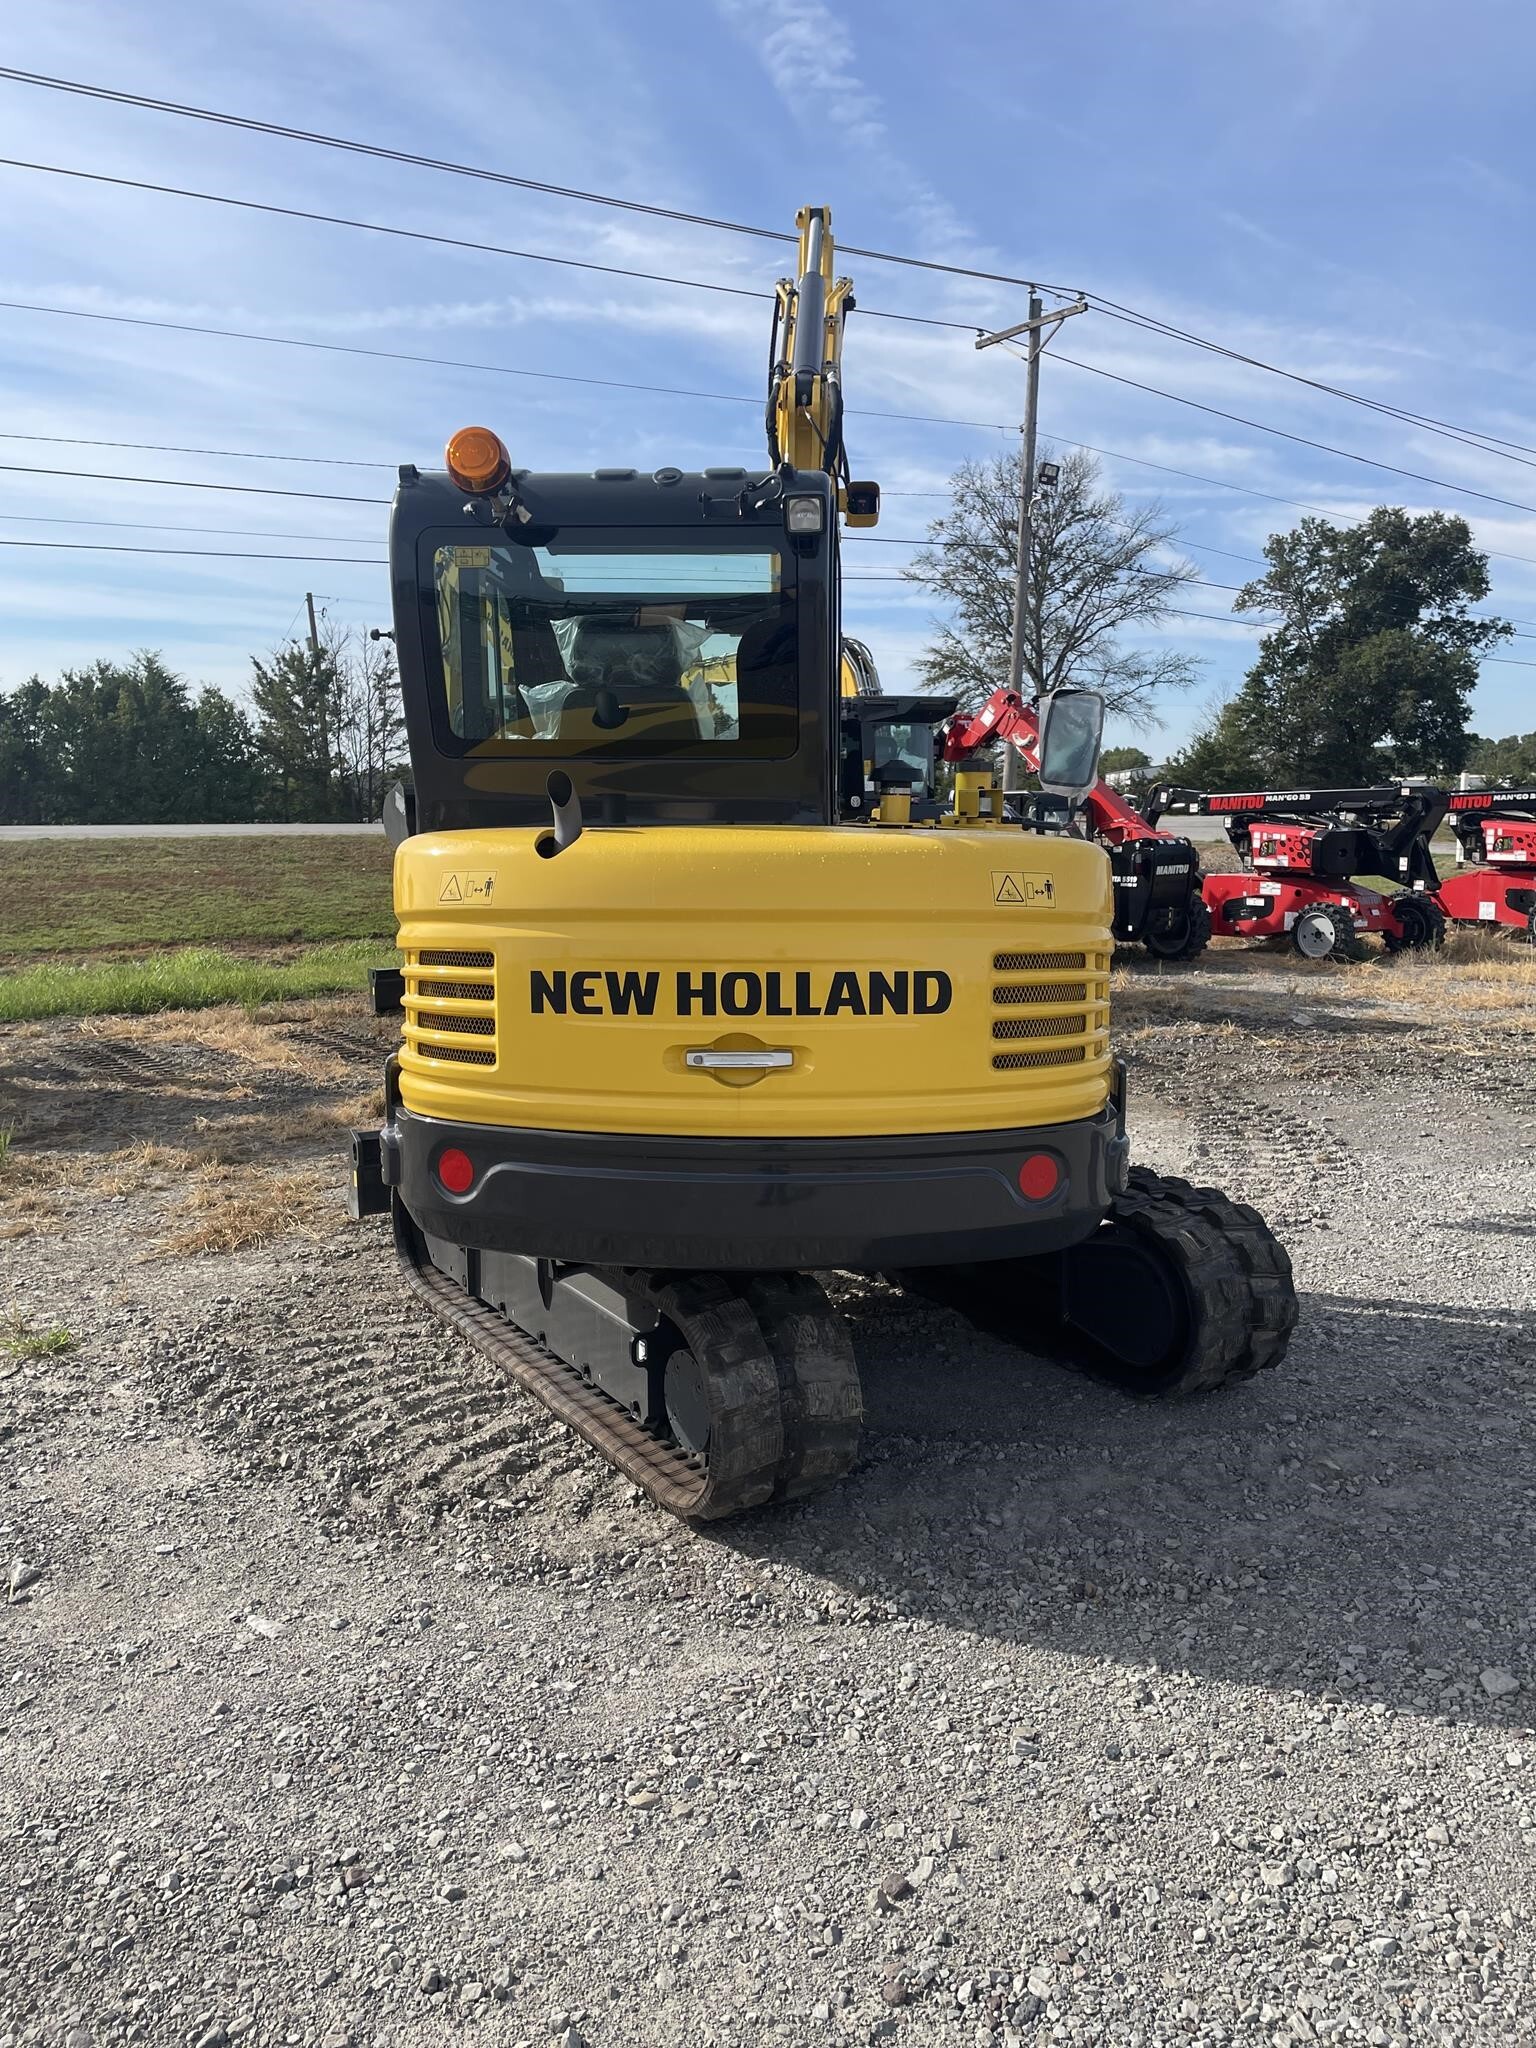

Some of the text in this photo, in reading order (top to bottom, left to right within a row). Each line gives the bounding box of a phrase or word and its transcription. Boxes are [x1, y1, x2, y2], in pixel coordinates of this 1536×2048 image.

[1210, 795, 1265, 810] MANITOU
[1450, 794, 1493, 809] NITOU
[1156, 864, 1190, 875] MANITOU
[530, 970, 953, 1016] NEW HOLLAND
